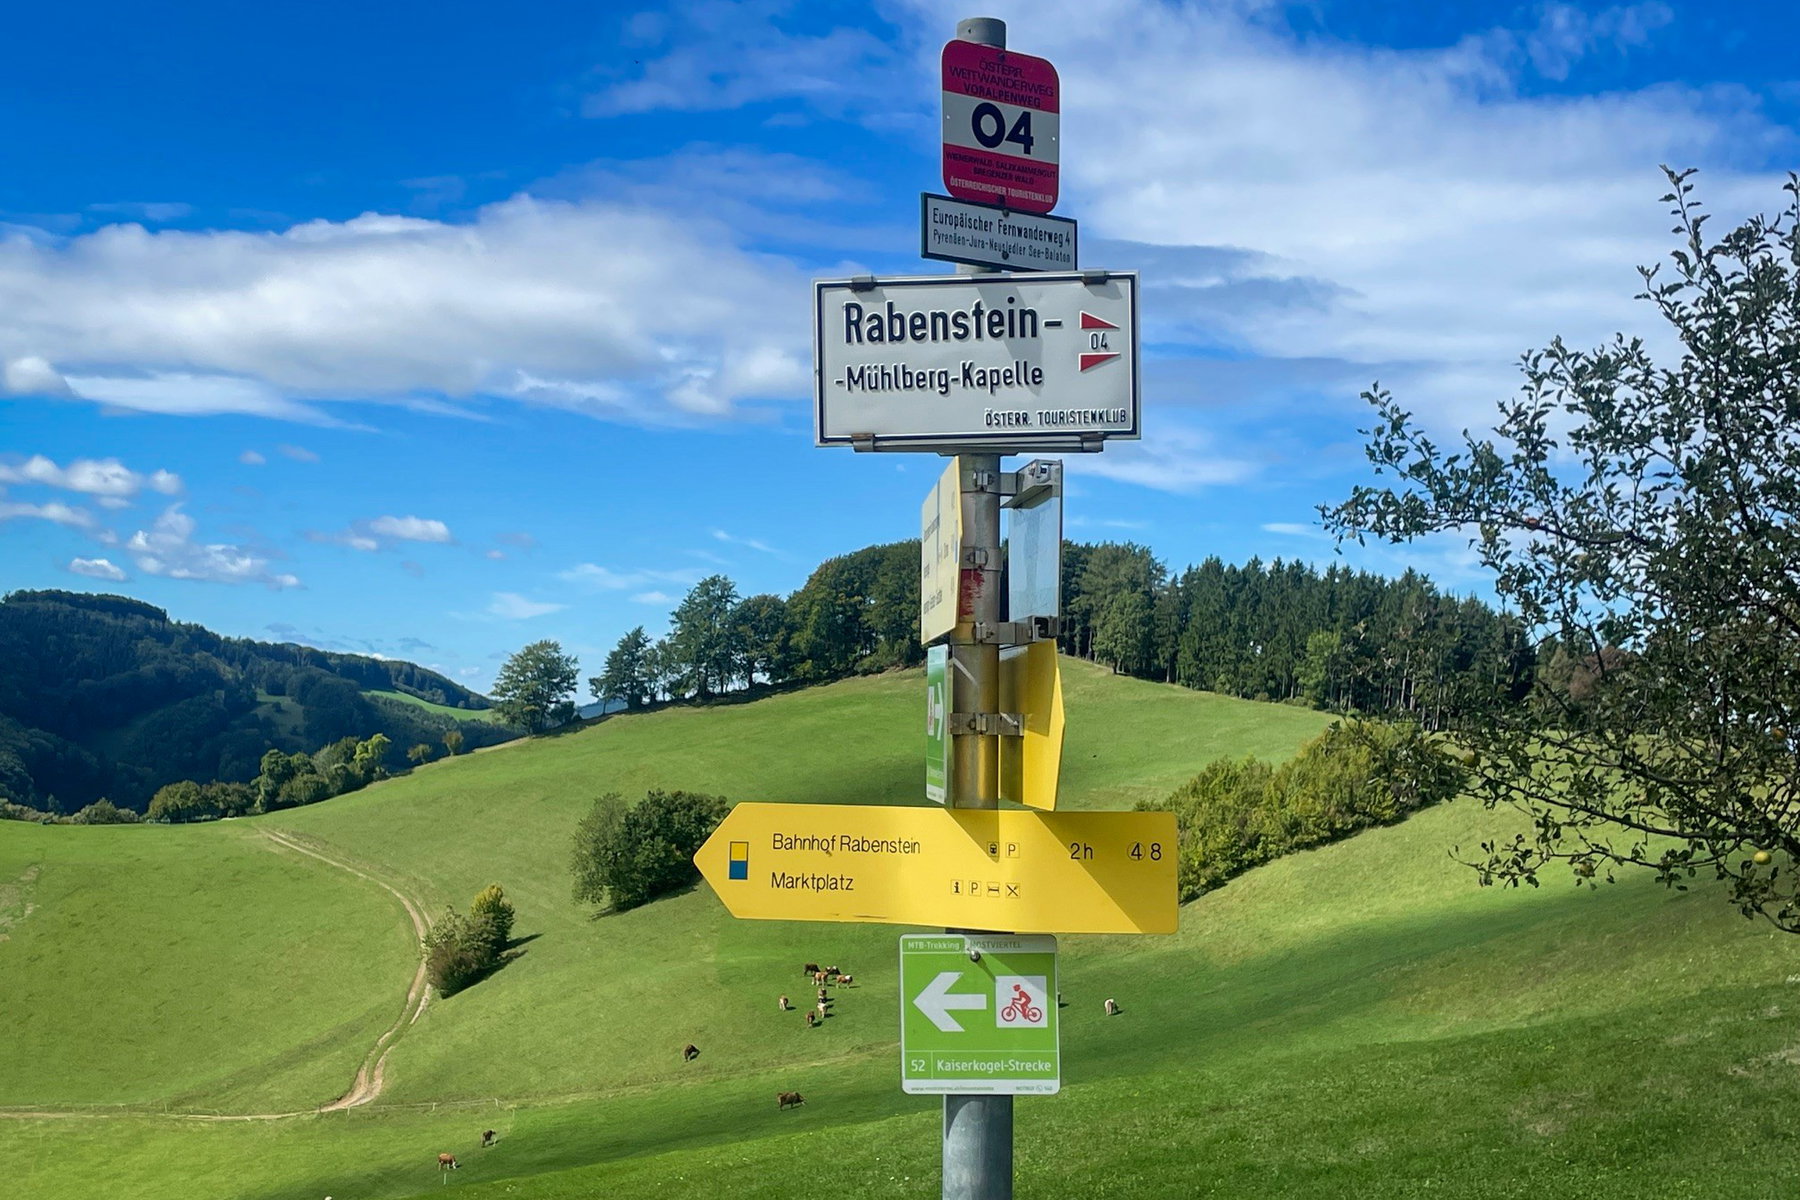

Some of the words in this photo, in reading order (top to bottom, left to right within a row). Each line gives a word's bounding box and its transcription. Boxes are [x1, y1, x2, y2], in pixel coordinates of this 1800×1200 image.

[949, 65, 1054, 97] WEITWANDERWEG
[963, 83, 1041, 108] VORALPENWEG
[972, 102, 1034, 155] 04
[949, 176, 1007, 196] ÖSTERREICHISCHER
[1008, 186, 1054, 204] TOURISTENKLUB
[933, 207, 994, 233] Europäischer
[998, 219, 1064, 247] Fernwanderweg
[1065, 230, 1071, 247] 4
[1028, 244, 1071, 264] See-Balaton
[1090, 332, 1109, 350] 04
[984, 408, 1033, 427] ÖSTERR.
[1037, 408, 1127, 425] TOURISTENKLUB
[773, 833, 837, 852] Bahnhof
[840, 835, 921, 854] Rabenstein
[771, 872, 854, 893] Marktplatz
[908, 940, 960, 950] MTB-Trekking
[911, 1059, 925, 1072] 52
[937, 1059, 1051, 1073] Kaiserkogel-Strecke
